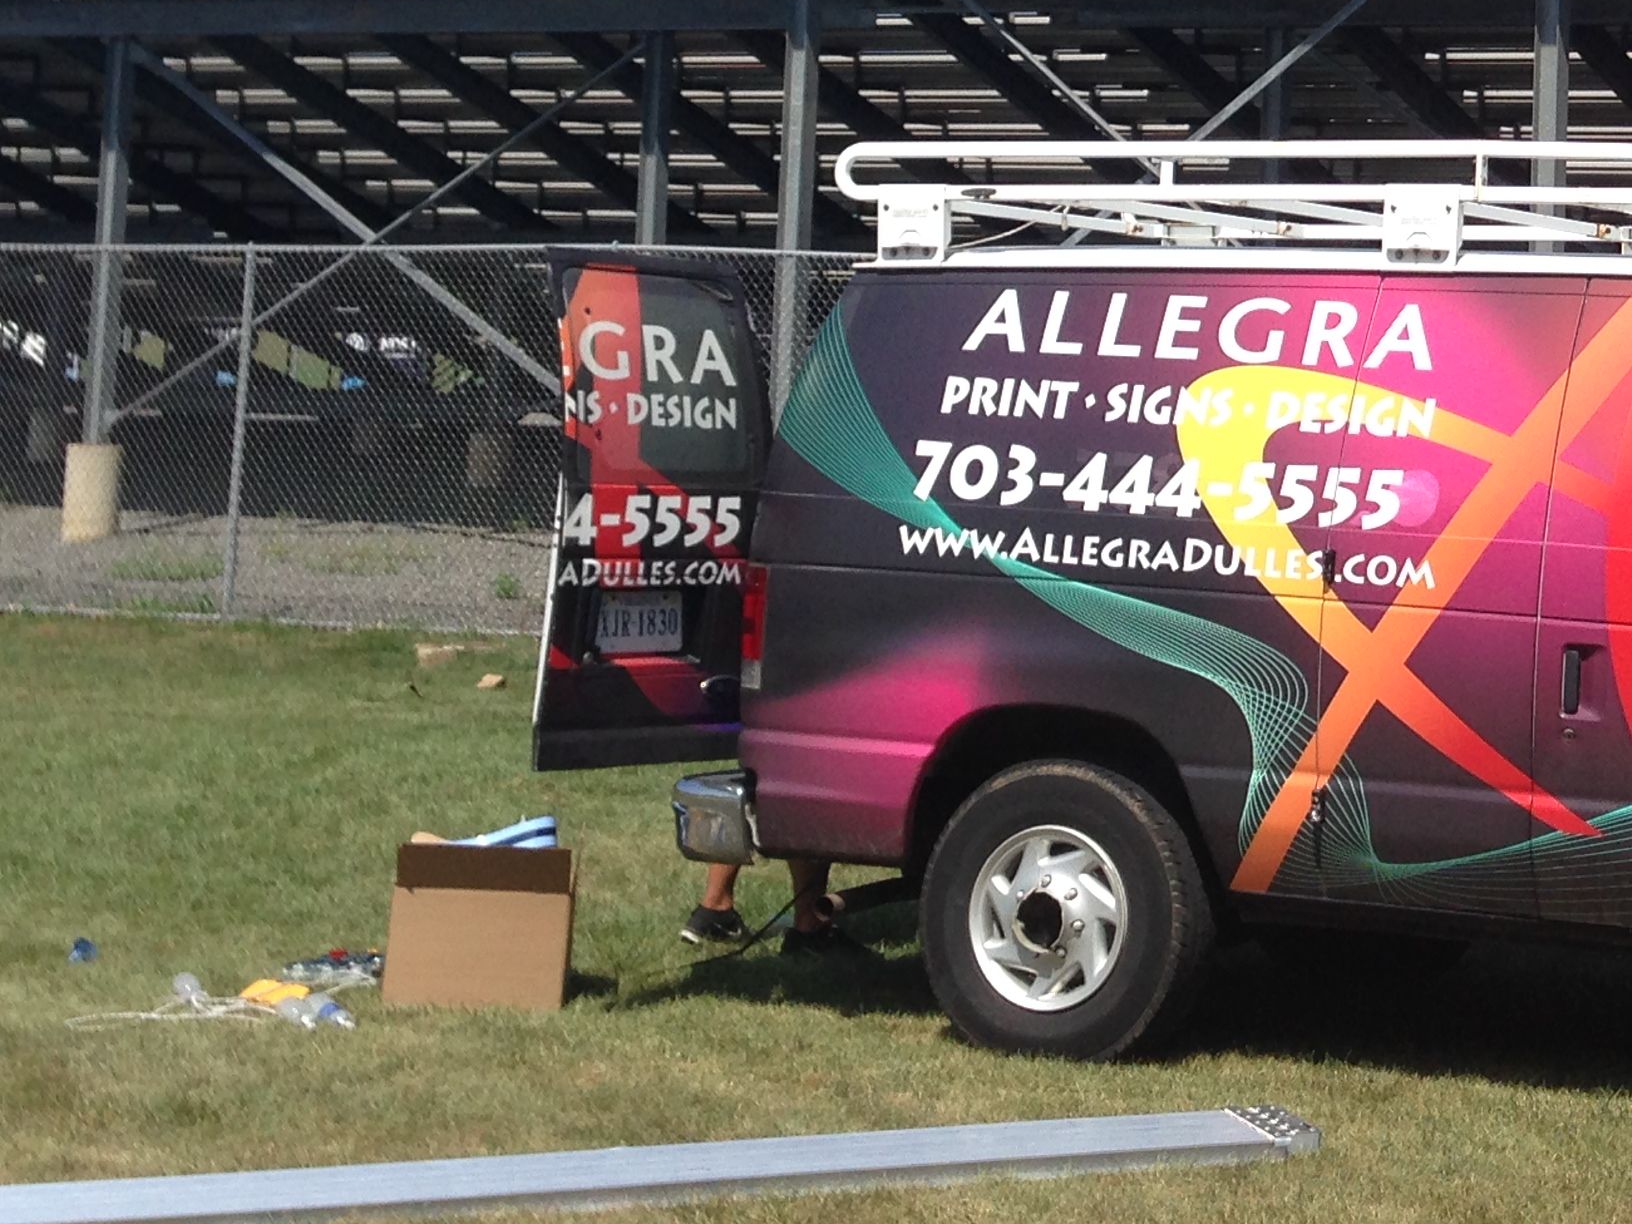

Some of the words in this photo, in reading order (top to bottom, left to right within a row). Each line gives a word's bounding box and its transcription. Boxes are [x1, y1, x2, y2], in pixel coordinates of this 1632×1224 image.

[961, 288, 1433, 371] ALLEGRA
[627, 392, 737, 429] DESIGN
[940, 376, 1079, 419] PRINT
[1105, 382, 1233, 426] SIGNS
[1265, 391, 1436, 439] DESIGN
[912, 439, 1404, 531] 703-444-5555
[565, 492, 741, 547] 4-5555
